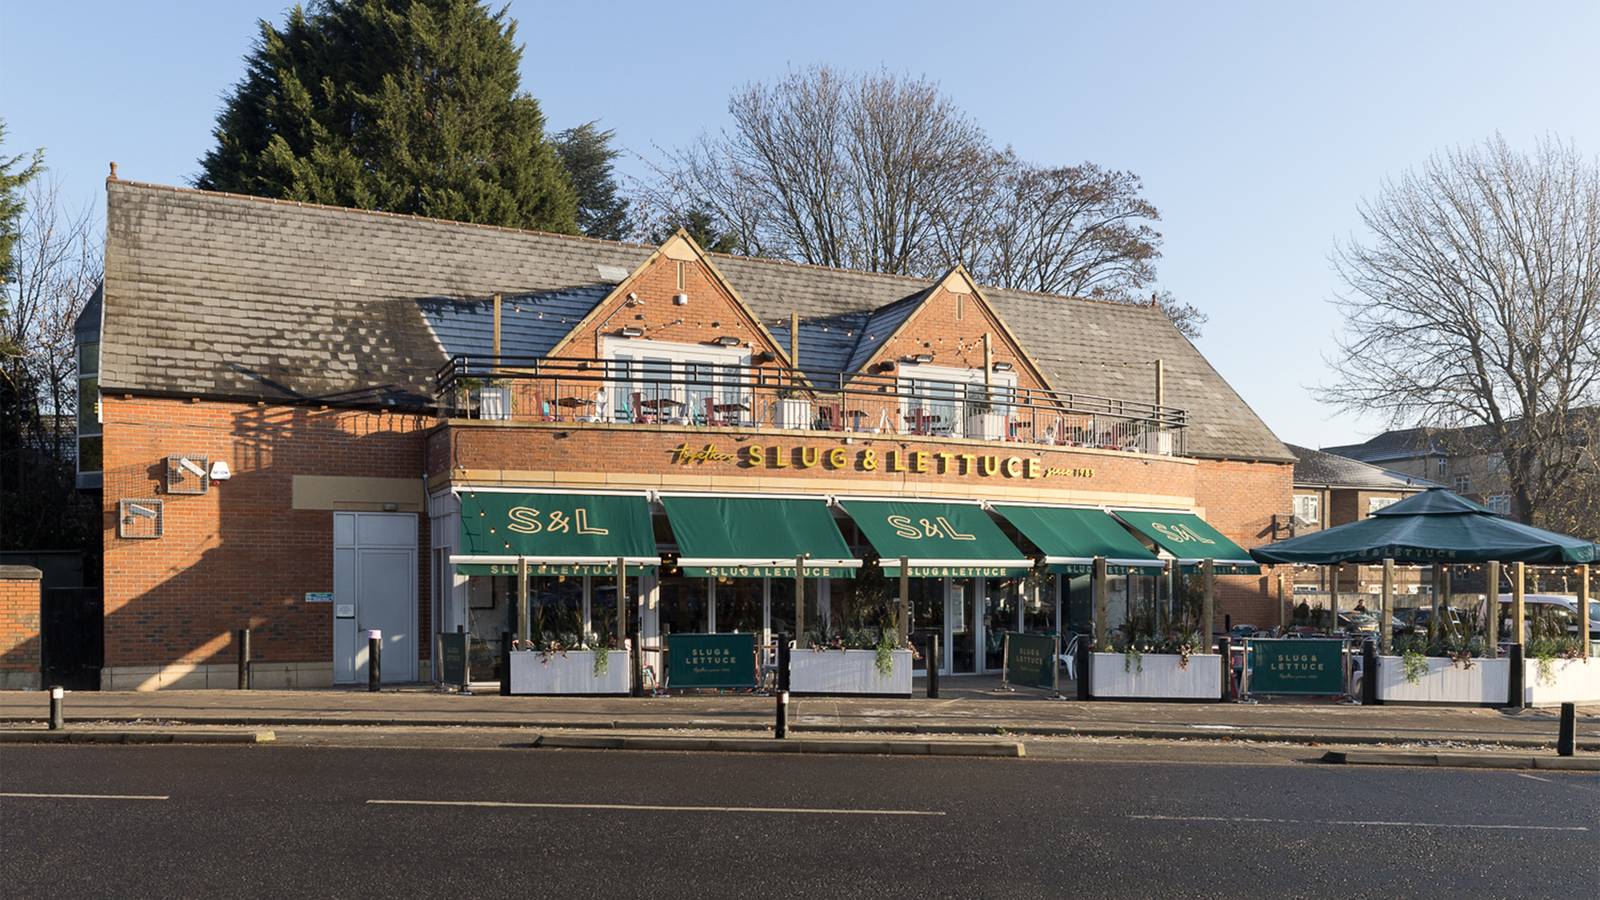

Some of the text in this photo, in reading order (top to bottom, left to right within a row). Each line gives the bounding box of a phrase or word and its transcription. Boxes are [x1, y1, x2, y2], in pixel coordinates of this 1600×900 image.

[749, 444, 848, 469] SLUG
[862, 448, 878, 471] &
[894, 449, 1041, 478] LETTUCE
[507, 506, 609, 535] S&L
[887, 515, 977, 541] S&L
[551, 565, 619, 575] LETTUC
[711, 567, 749, 577] SLUG
[907, 567, 938, 576] SLUG
[952, 568, 1007, 577] LETTUCE
[685, 656, 736, 664] LETTUCE
[1270, 663, 1324, 671] LETTUCE
